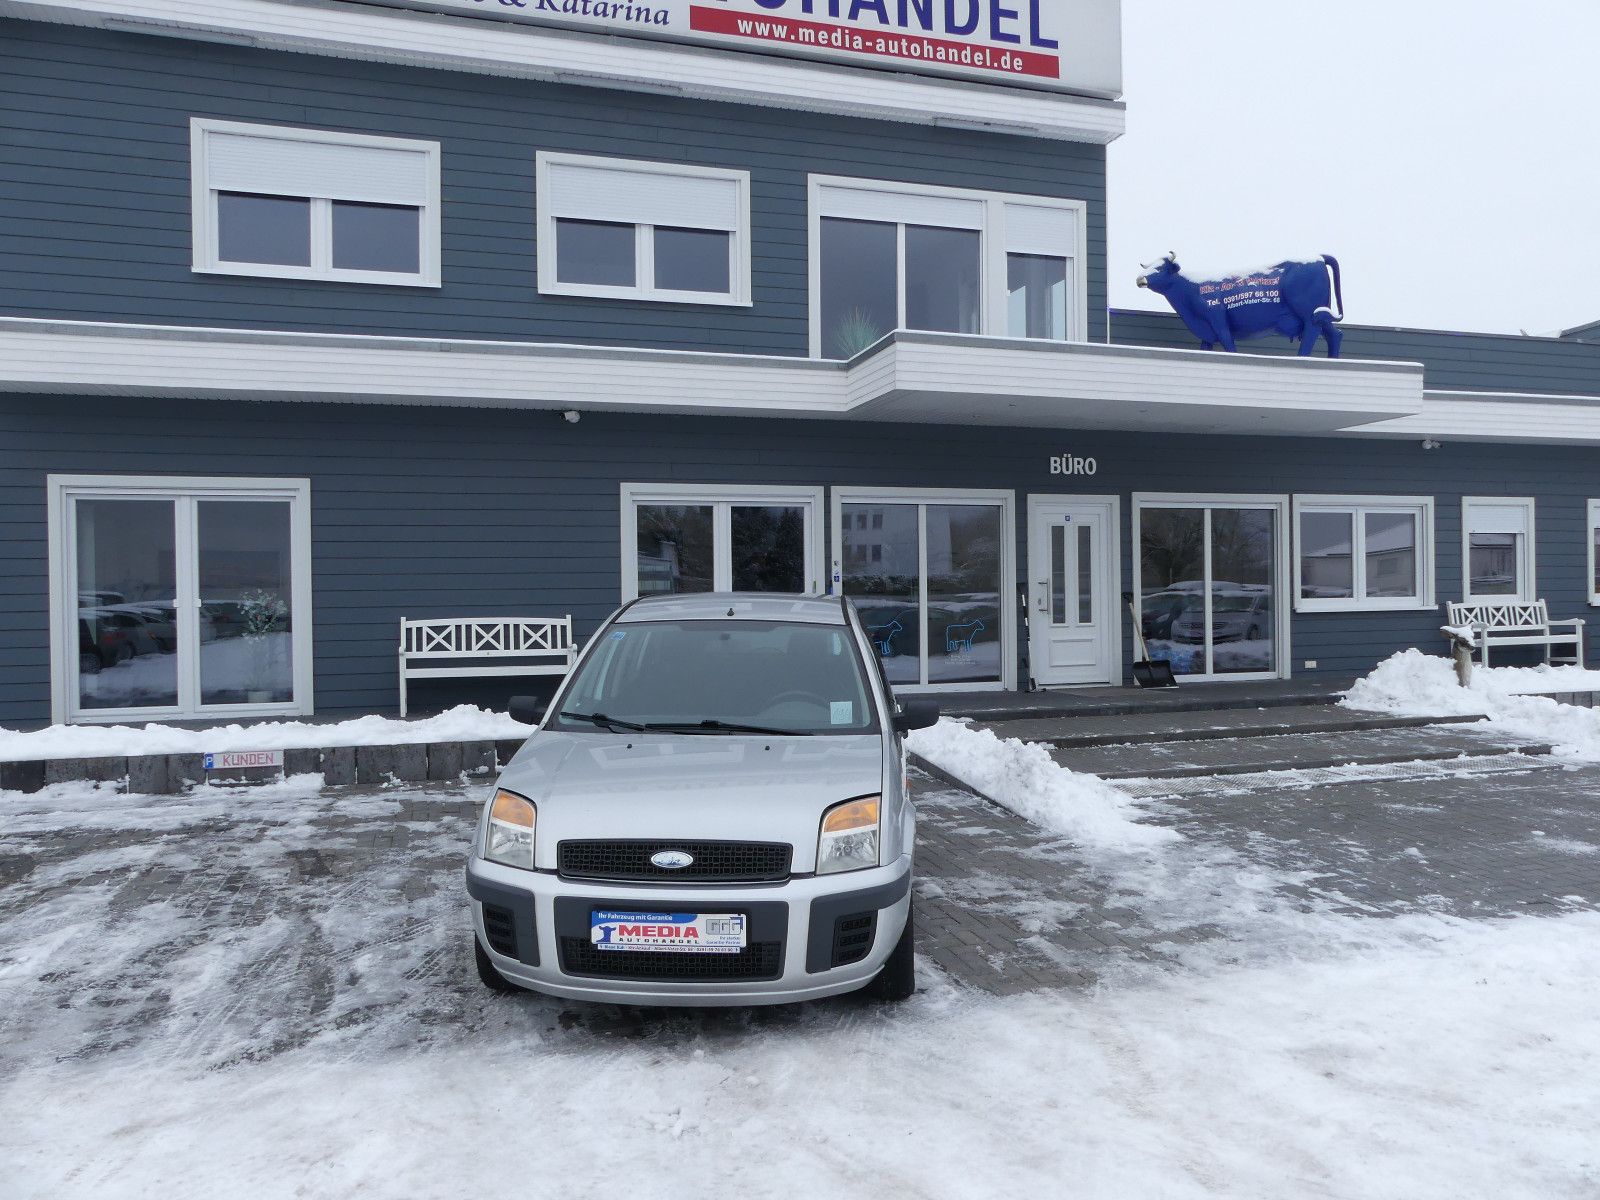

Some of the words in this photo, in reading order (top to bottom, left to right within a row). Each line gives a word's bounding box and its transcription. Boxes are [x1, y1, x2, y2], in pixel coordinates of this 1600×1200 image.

[737, 18, 1024, 72] www.media-autohandel.de
[1206, 299, 1220, 307] Tel.
[1049, 453, 1097, 475] BÜRO
[223, 753, 274, 766] KUNDEN
[608, 913, 635, 921] Fahrzeug
[618, 924, 700, 938] MEDIA
